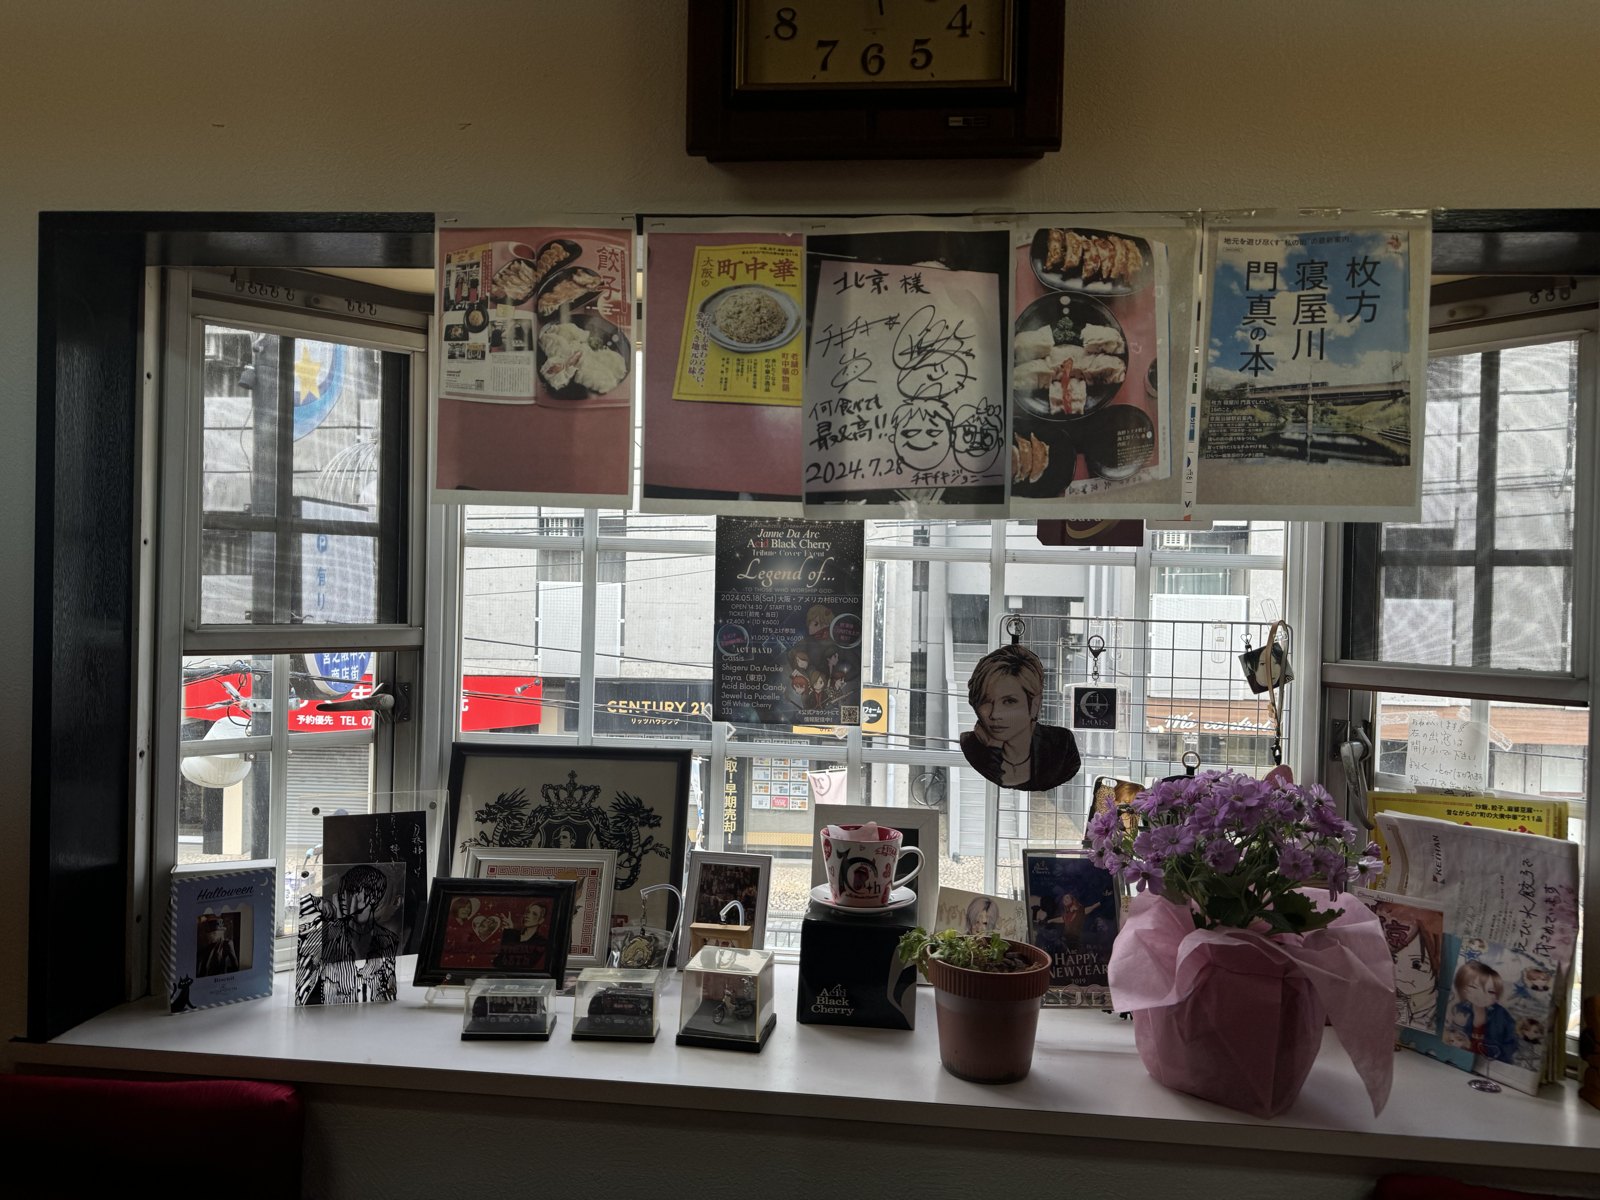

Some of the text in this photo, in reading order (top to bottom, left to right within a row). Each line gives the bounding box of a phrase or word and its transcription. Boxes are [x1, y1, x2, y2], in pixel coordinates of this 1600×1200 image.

[774, 7, 797, 41] 8
[946, 4, 973, 38] 4
[816, 40, 840, 72] 7
[861, 43, 886, 75] 6
[910, 38, 933, 70] 5
[701, 256, 714, 287] 大阪の
[718, 256, 799, 282] 町中華
[833, 269, 931, 295] 北京 様
[1345, 255, 1382, 323] 枚方
[1239, 260, 1278, 377] 門真の本
[1292, 259, 1328, 361] 寝屋川
[747, 539, 832, 551] Acid Black Cherry
[757, 528, 820, 539] Janne Da Arc
[737, 555, 814, 587] Legend
[762, 683, 787, 692] Candy
[607, 700, 687, 714] CENTURY
[733, 700, 751, 708] White
[296, 714, 334, 725] 予約優先
[339, 715, 357, 726] TEL
[197, 885, 254, 901] Halloween
[1054, 952, 1099, 966] HAPPY
[816, 996, 850, 1006] Black
[820, 986, 848, 997] Acid
[811, 1004, 856, 1016] Cherry
